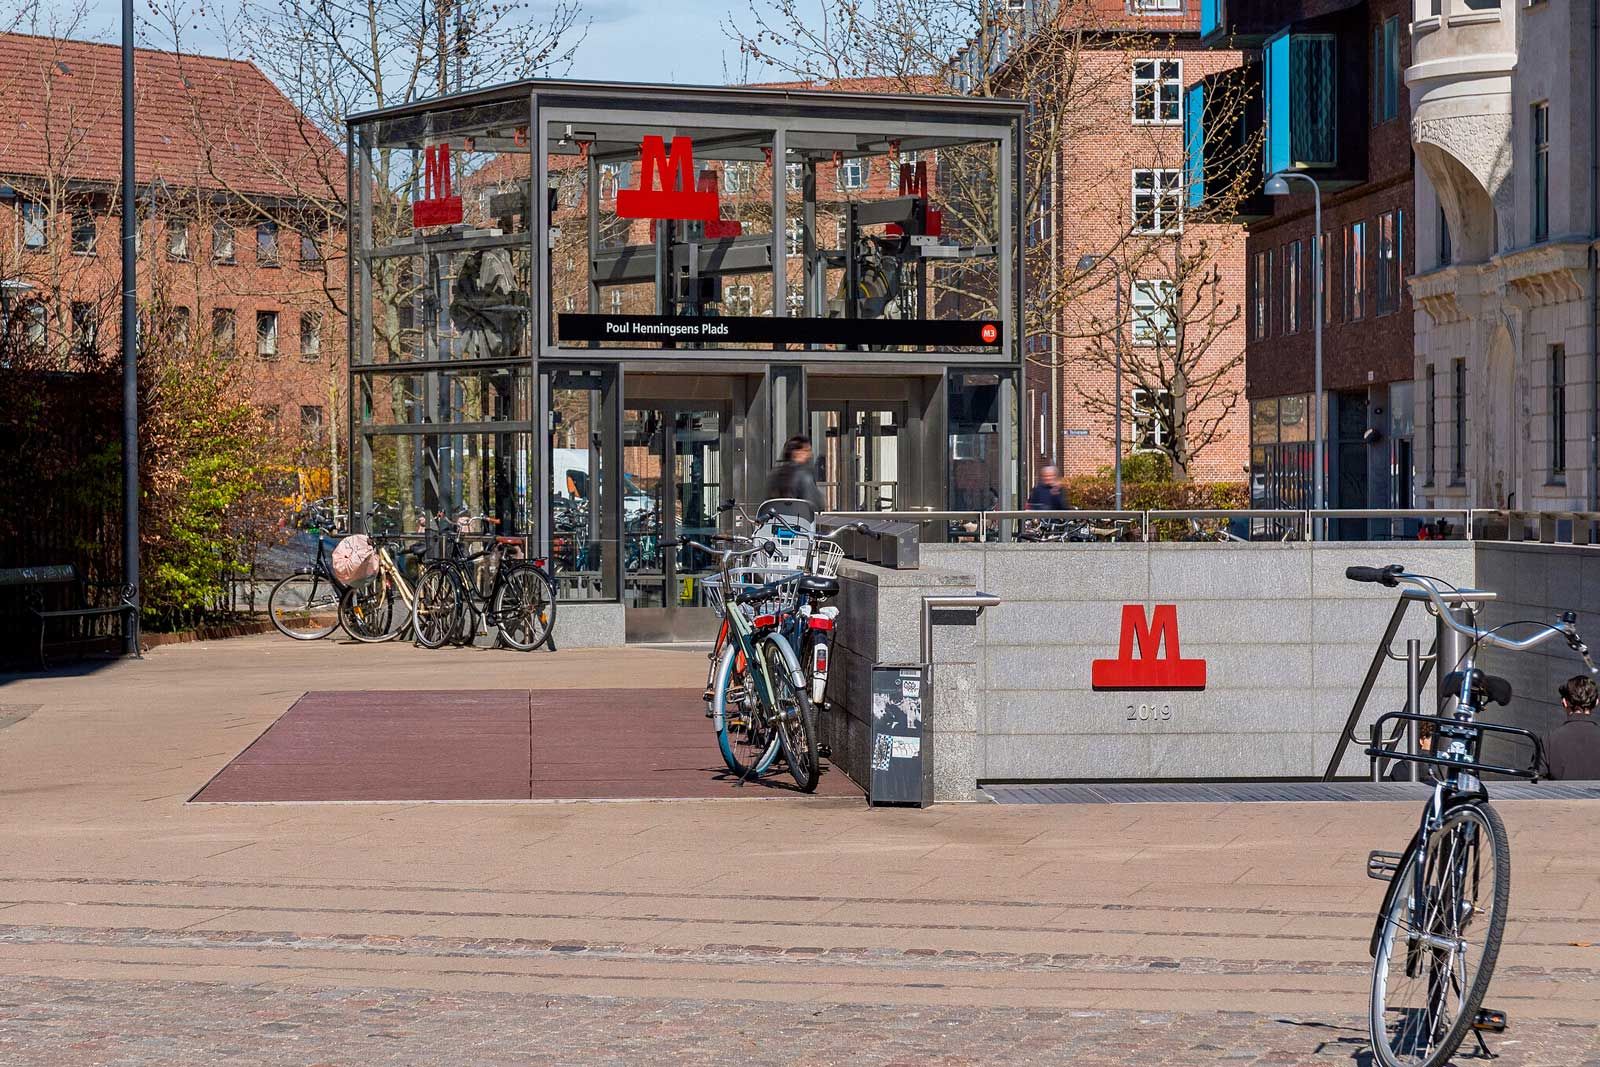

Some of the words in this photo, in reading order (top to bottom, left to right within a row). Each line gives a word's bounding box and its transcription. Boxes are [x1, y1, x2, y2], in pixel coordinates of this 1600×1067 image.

[606, 322, 629, 333] Poul
[632, 323, 699, 336] Henningsens
[702, 323, 729, 334] Plads
[983, 329, 995, 337] M3
[1126, 704, 1172, 721] 2019
